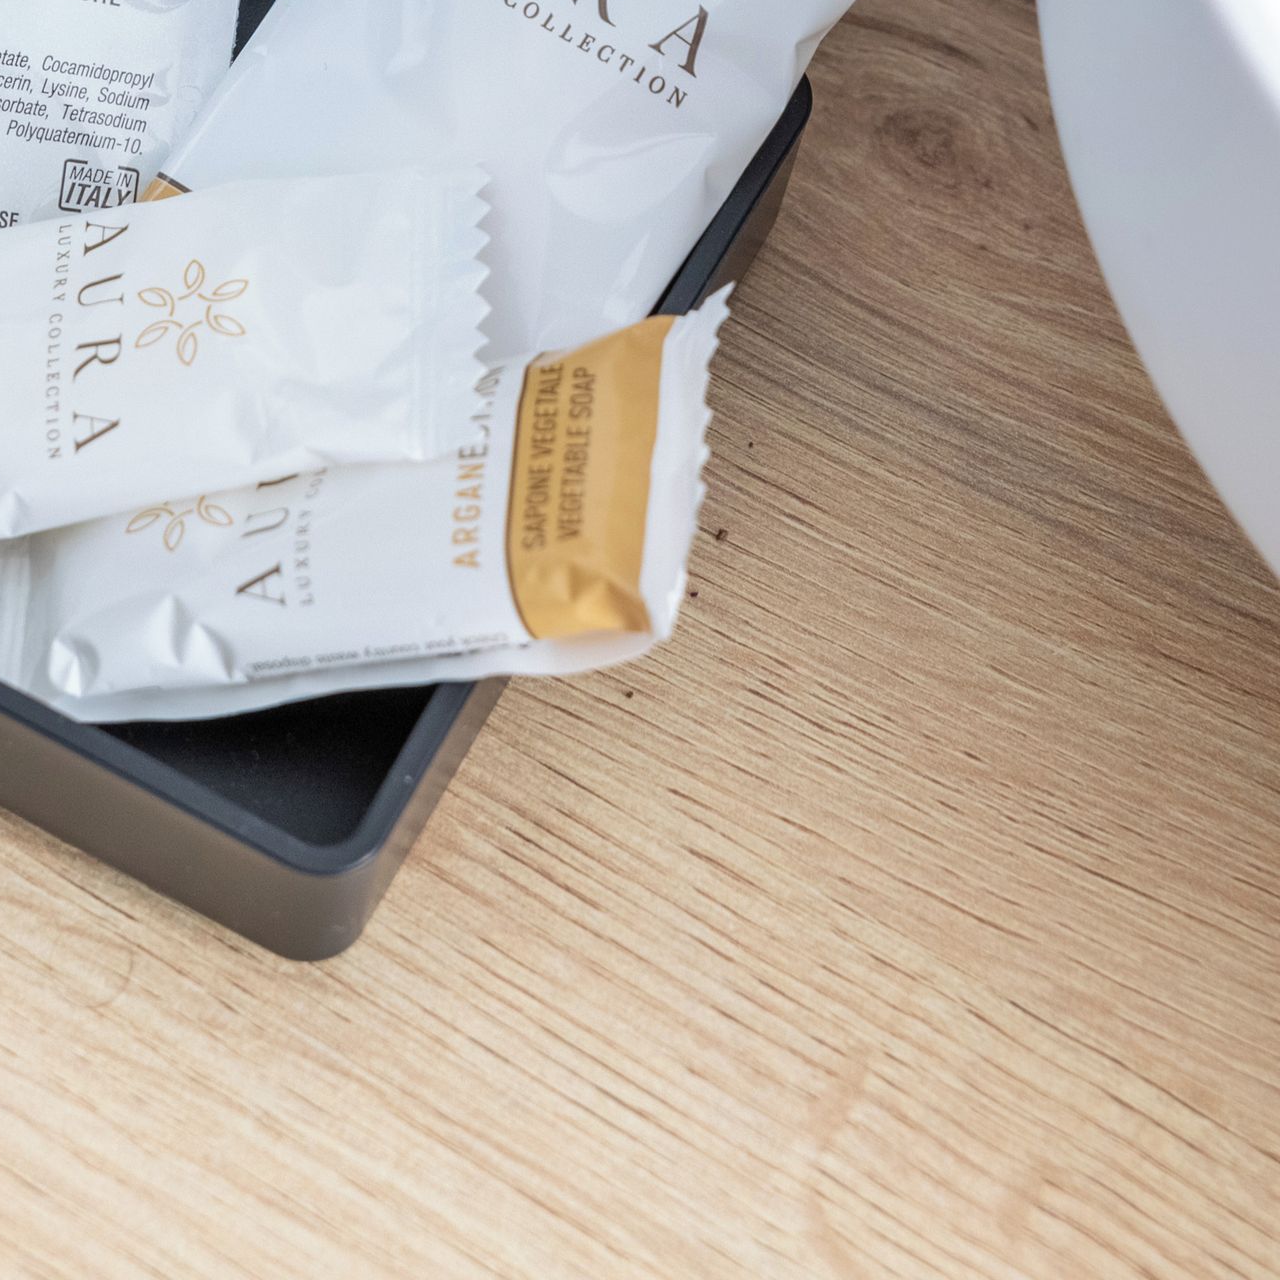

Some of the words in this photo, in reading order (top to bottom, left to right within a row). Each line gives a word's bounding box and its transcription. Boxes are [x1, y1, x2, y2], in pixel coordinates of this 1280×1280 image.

[41, 55, 155, 88] Cocamidopropyl
[41, 78, 90, 102] Lysine,
[97, 87, 150, 111] Sodium
[6, 119, 143, 155] Polyquaternium-10.
[62, 104, 148, 133] Tetrasodium
[64, 182, 132, 209] ITALY
[69, 165, 115, 185] MADE
[118, 171, 133, 188] IN
[51, 223, 73, 304] LUXURY
[72, 220, 129, 456] AURA
[45, 312, 64, 461] COLLECTION
[530, 361, 565, 457] VEGETALE
[558, 422, 592, 541] VEGETABLE
[575, 365, 598, 421] SOAP
[521, 461, 557, 552] SAPONE
